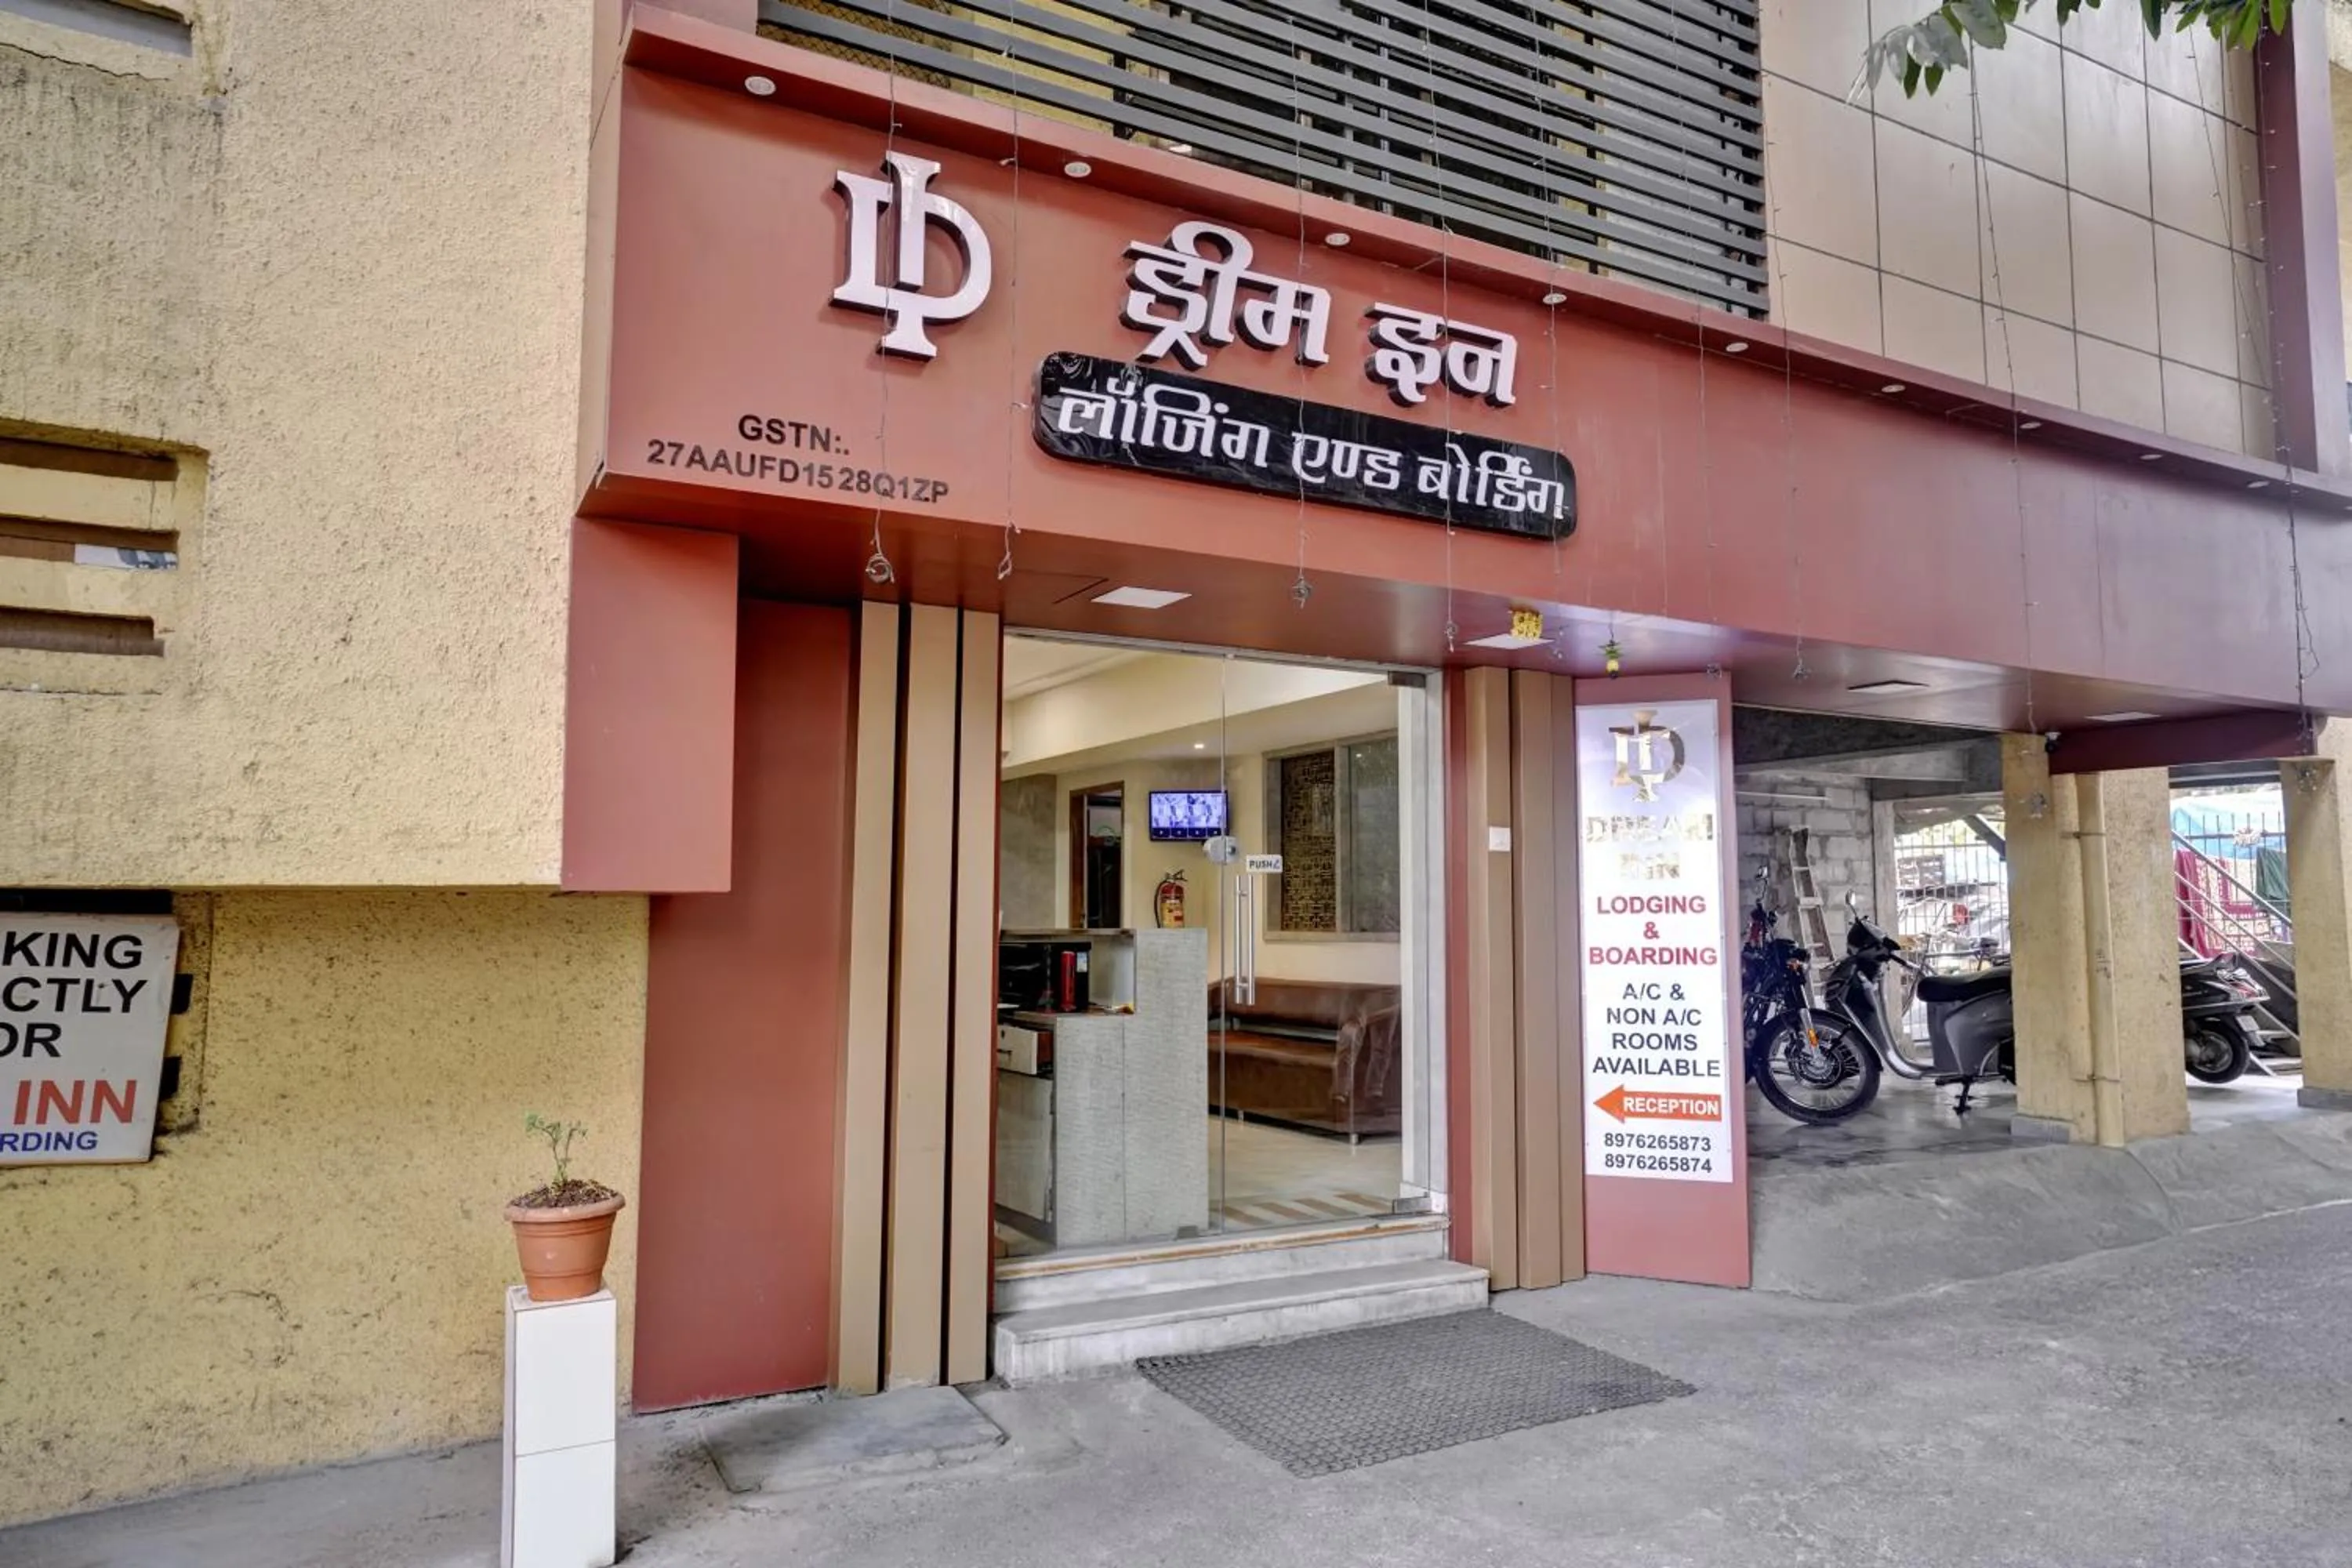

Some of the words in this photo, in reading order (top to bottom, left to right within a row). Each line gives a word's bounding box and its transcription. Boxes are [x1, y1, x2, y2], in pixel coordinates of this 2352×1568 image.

[1366, 302, 1517, 405] इन
[1058, 378, 1268, 467] लॉजिंग
[1291, 430, 1403, 490] एण्ड
[1249, 859, 1272, 869] PUSH
[1596, 895, 1706, 915] LODGING
[1643, 920, 1661, 940] &
[2, 931, 143, 969] KING
[1589, 946, 1719, 966] BOARDING
[2, 977, 148, 1014] CTLY
[1622, 982, 1661, 1001] A/C
[1669, 982, 1686, 1001] &
[1606, 1007, 1656, 1025] NON
[1662, 1008, 1703, 1026] A/C
[1612, 1033, 1698, 1051] ROOMS
[1592, 1057, 1721, 1078] AVAILABLE
[13, 1079, 137, 1126] INN
[1624, 1097, 1719, 1116] RECEPTION
[0, 1131, 99, 1153] RDING
[1604, 1133, 1712, 1152] 8976265873
[1604, 1153, 1713, 1174] 8976265874
